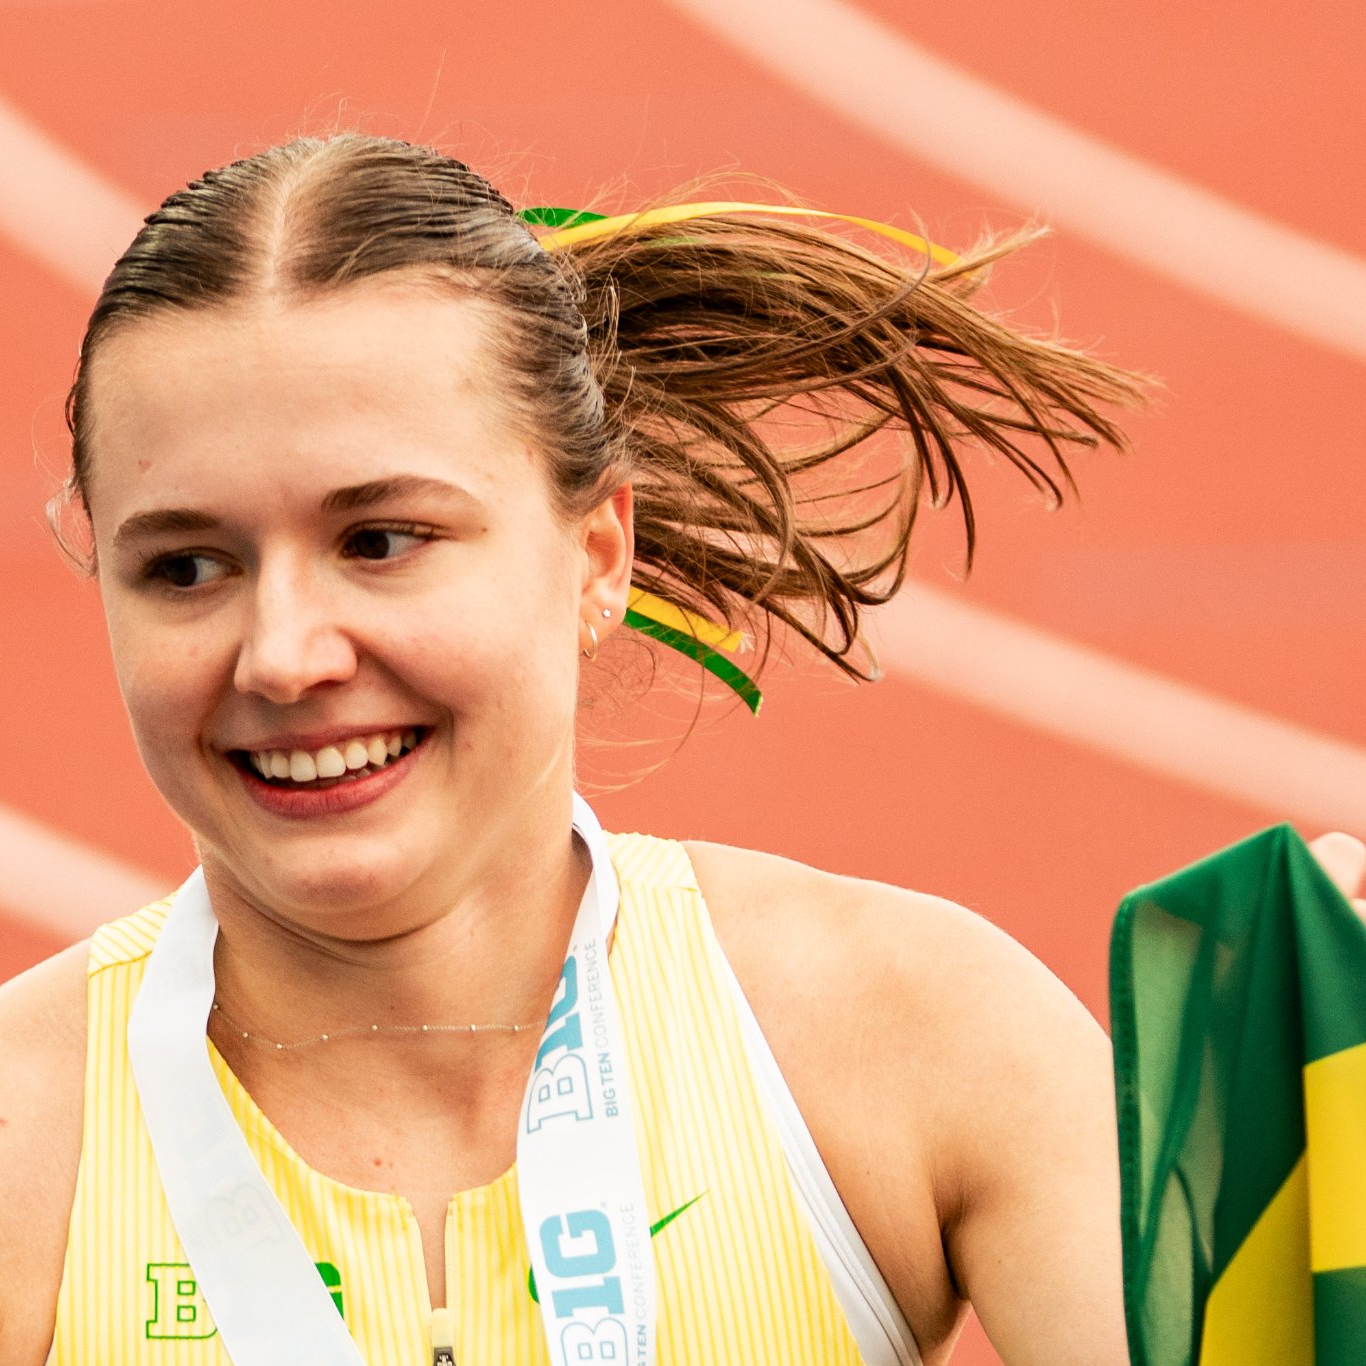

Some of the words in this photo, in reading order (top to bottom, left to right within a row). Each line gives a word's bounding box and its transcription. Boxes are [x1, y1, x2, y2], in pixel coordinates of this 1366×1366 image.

[585, 939, 610, 1048] CONFERENCE
[598, 1052, 614, 1087] TEN
[602, 1087, 619, 1118] BIG
[621, 1202, 647, 1319] CONFERENCE
[637, 1324, 647, 1359] TEN
